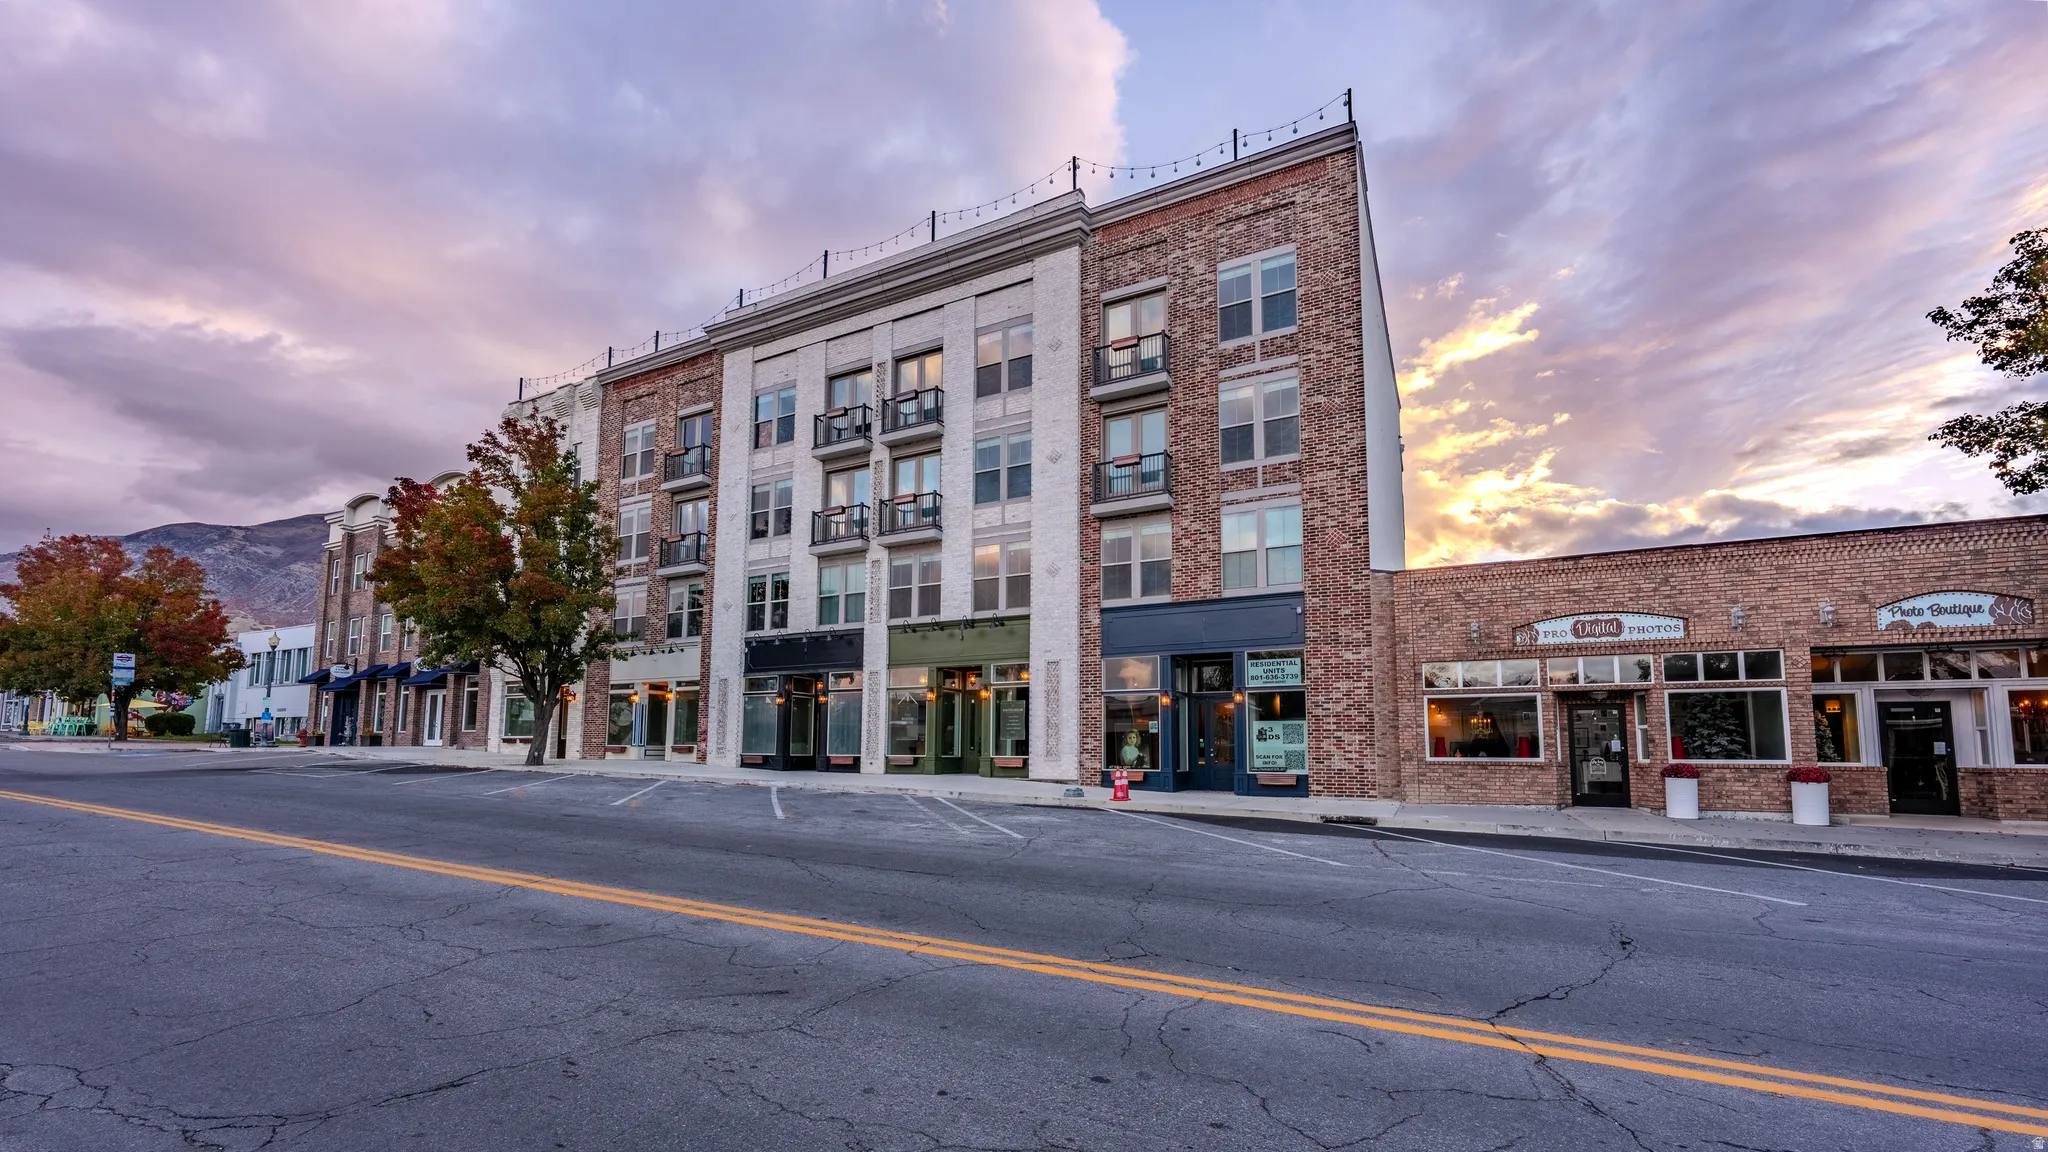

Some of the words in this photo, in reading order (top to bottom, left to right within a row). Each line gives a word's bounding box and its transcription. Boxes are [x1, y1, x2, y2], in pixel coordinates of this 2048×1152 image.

[1887, 605, 1925, 618] Photo
[1927, 603, 1985, 618] Boutique
[1543, 630, 1568, 639] PRO
[1575, 620, 1620, 636] Digital
[1628, 624, 1681, 635] PHOTOS
[1250, 660, 1298, 668] RESIDENTIAL
